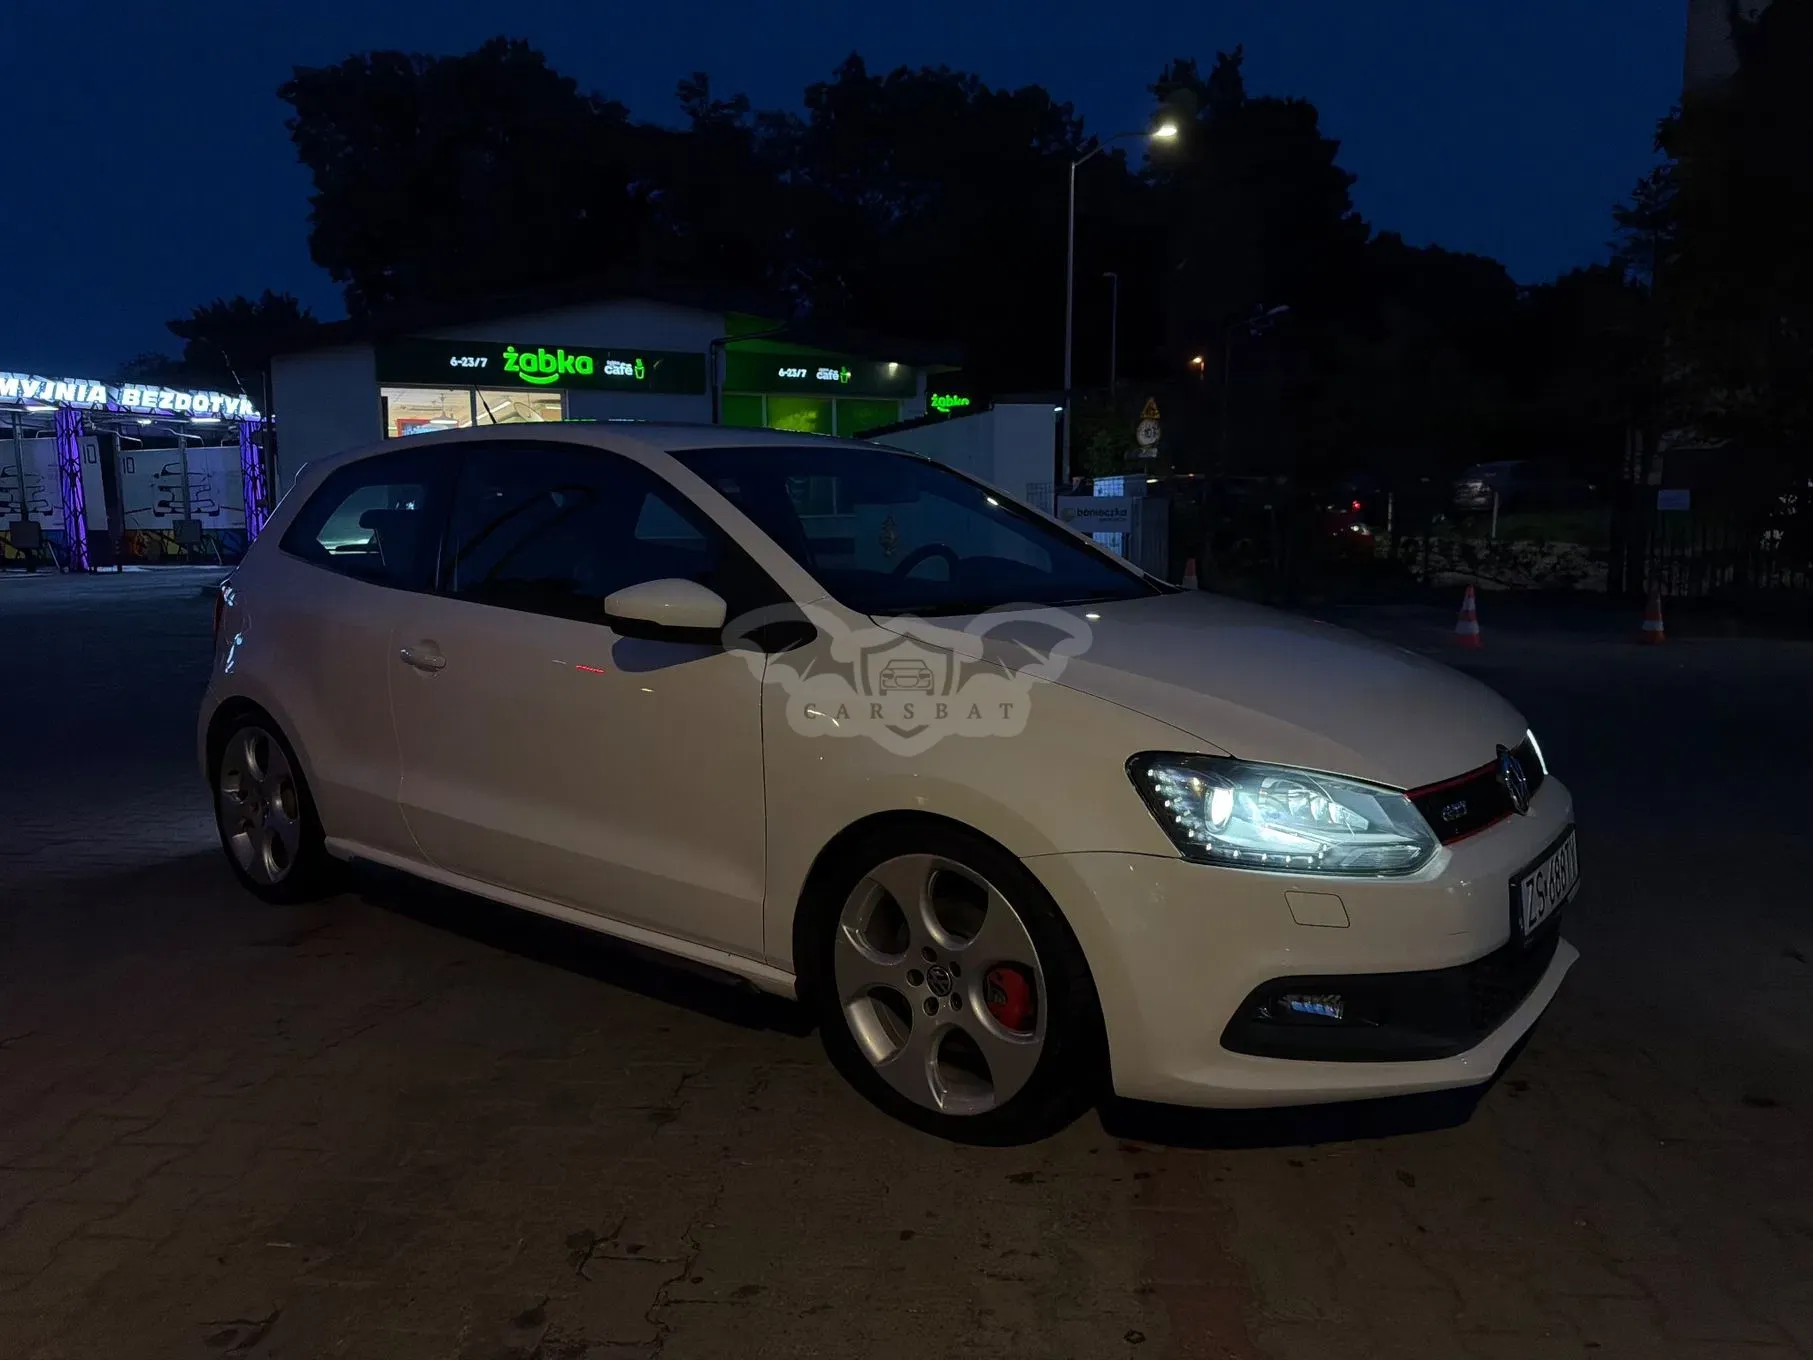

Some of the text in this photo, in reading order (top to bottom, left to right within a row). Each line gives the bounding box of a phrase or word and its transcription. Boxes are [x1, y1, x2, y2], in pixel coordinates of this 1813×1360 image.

[450, 356, 488, 368] 6-23/7
[503, 346, 593, 375] żabka
[778, 368, 807, 378] 6-23/7
[0, 378, 107, 403] MYJNIA
